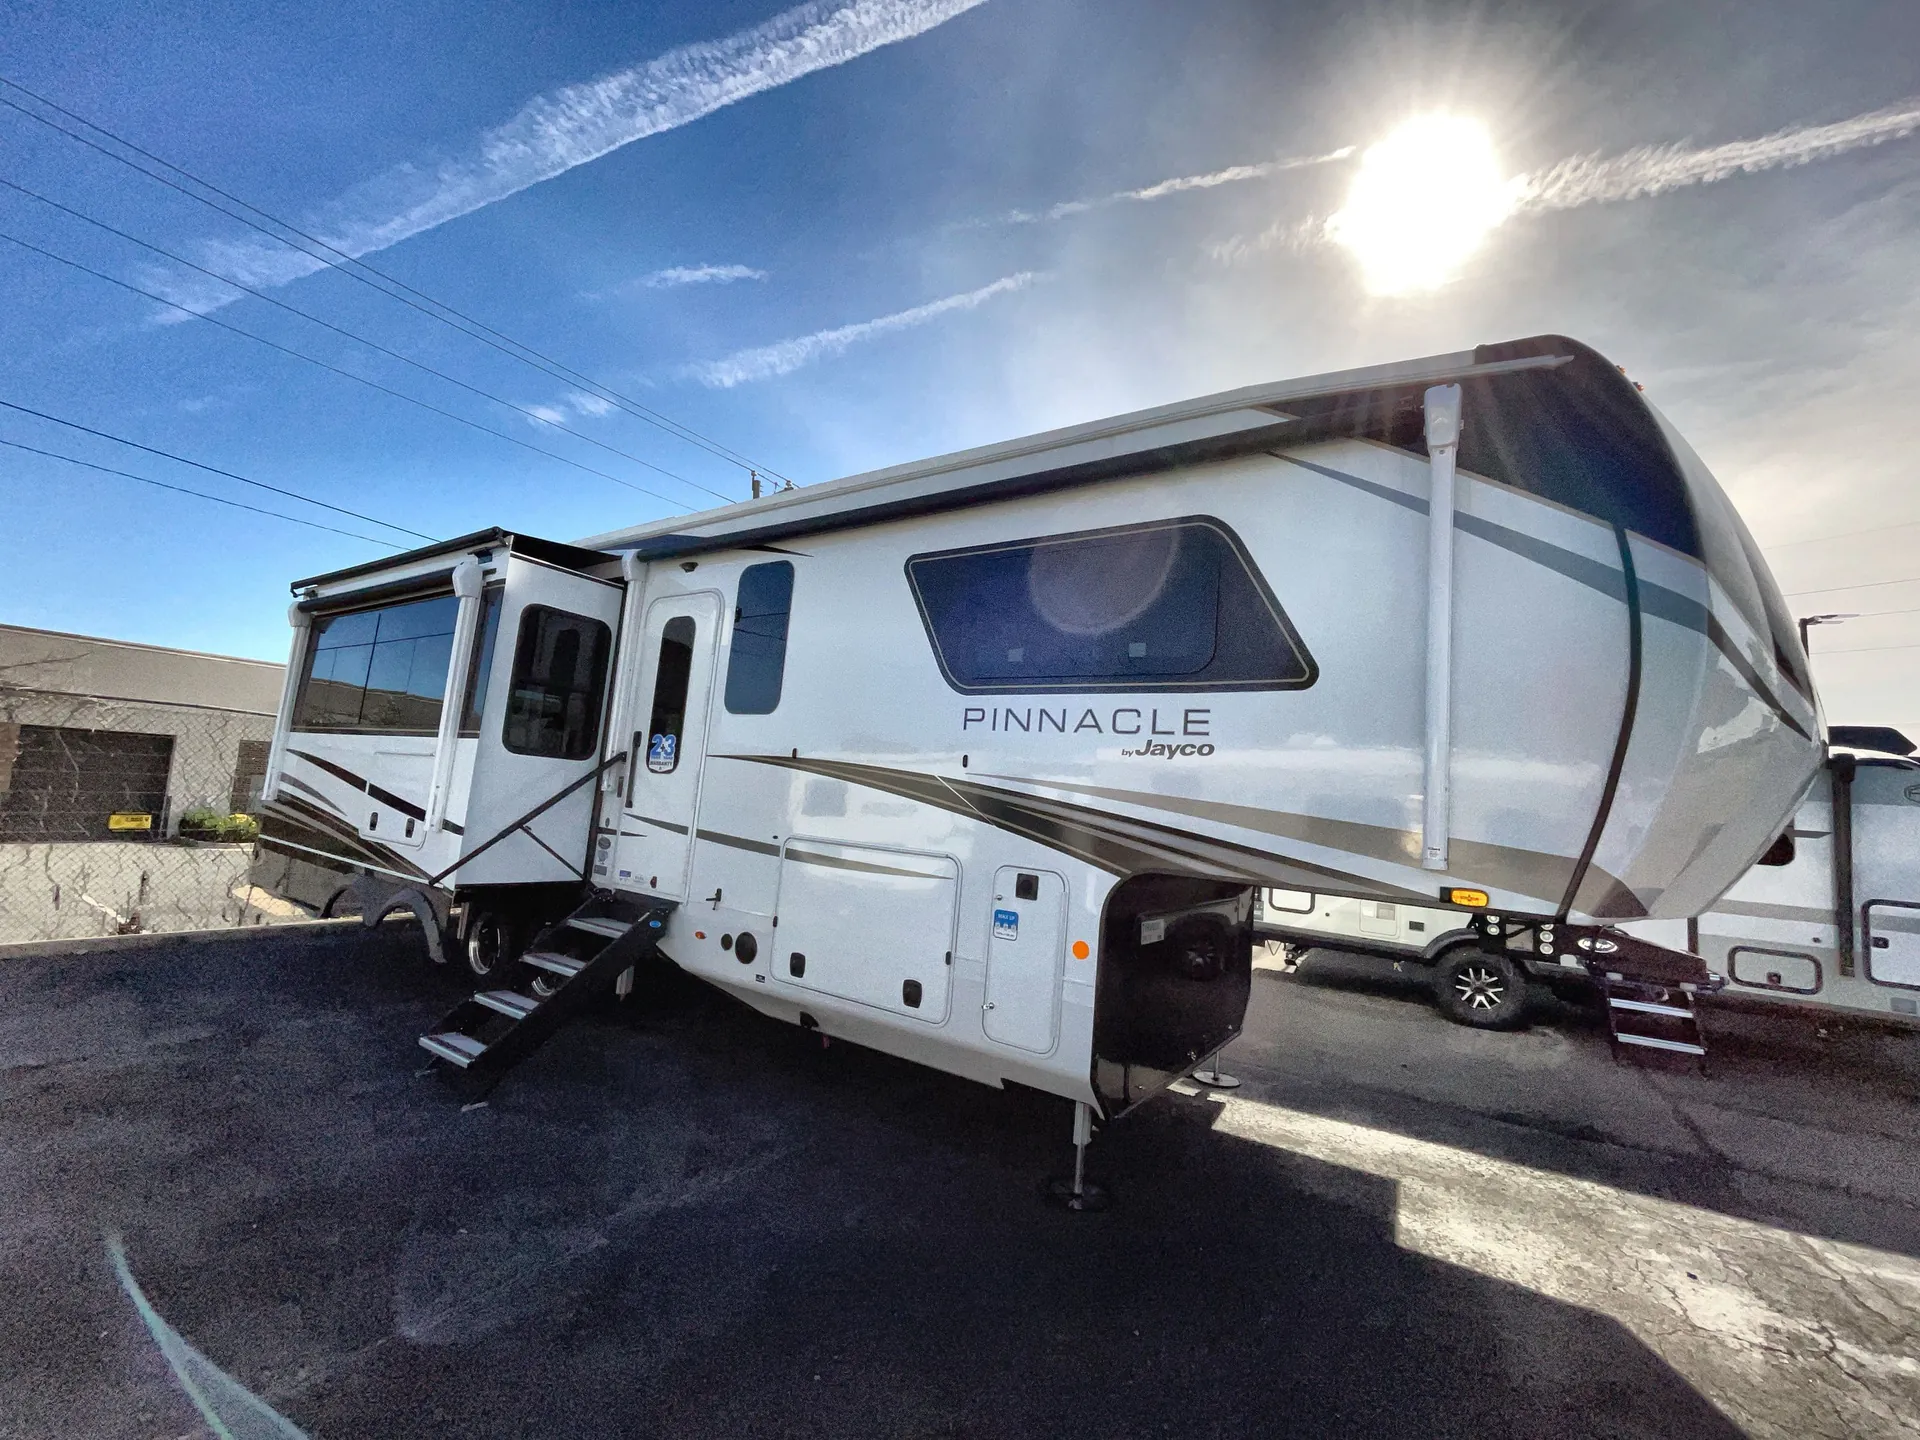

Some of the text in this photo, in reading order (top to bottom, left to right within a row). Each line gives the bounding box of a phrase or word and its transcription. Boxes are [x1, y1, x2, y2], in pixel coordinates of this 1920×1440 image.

[963, 708, 1211, 736] PINNACLE
[1121, 739, 1215, 760] by Jayco
